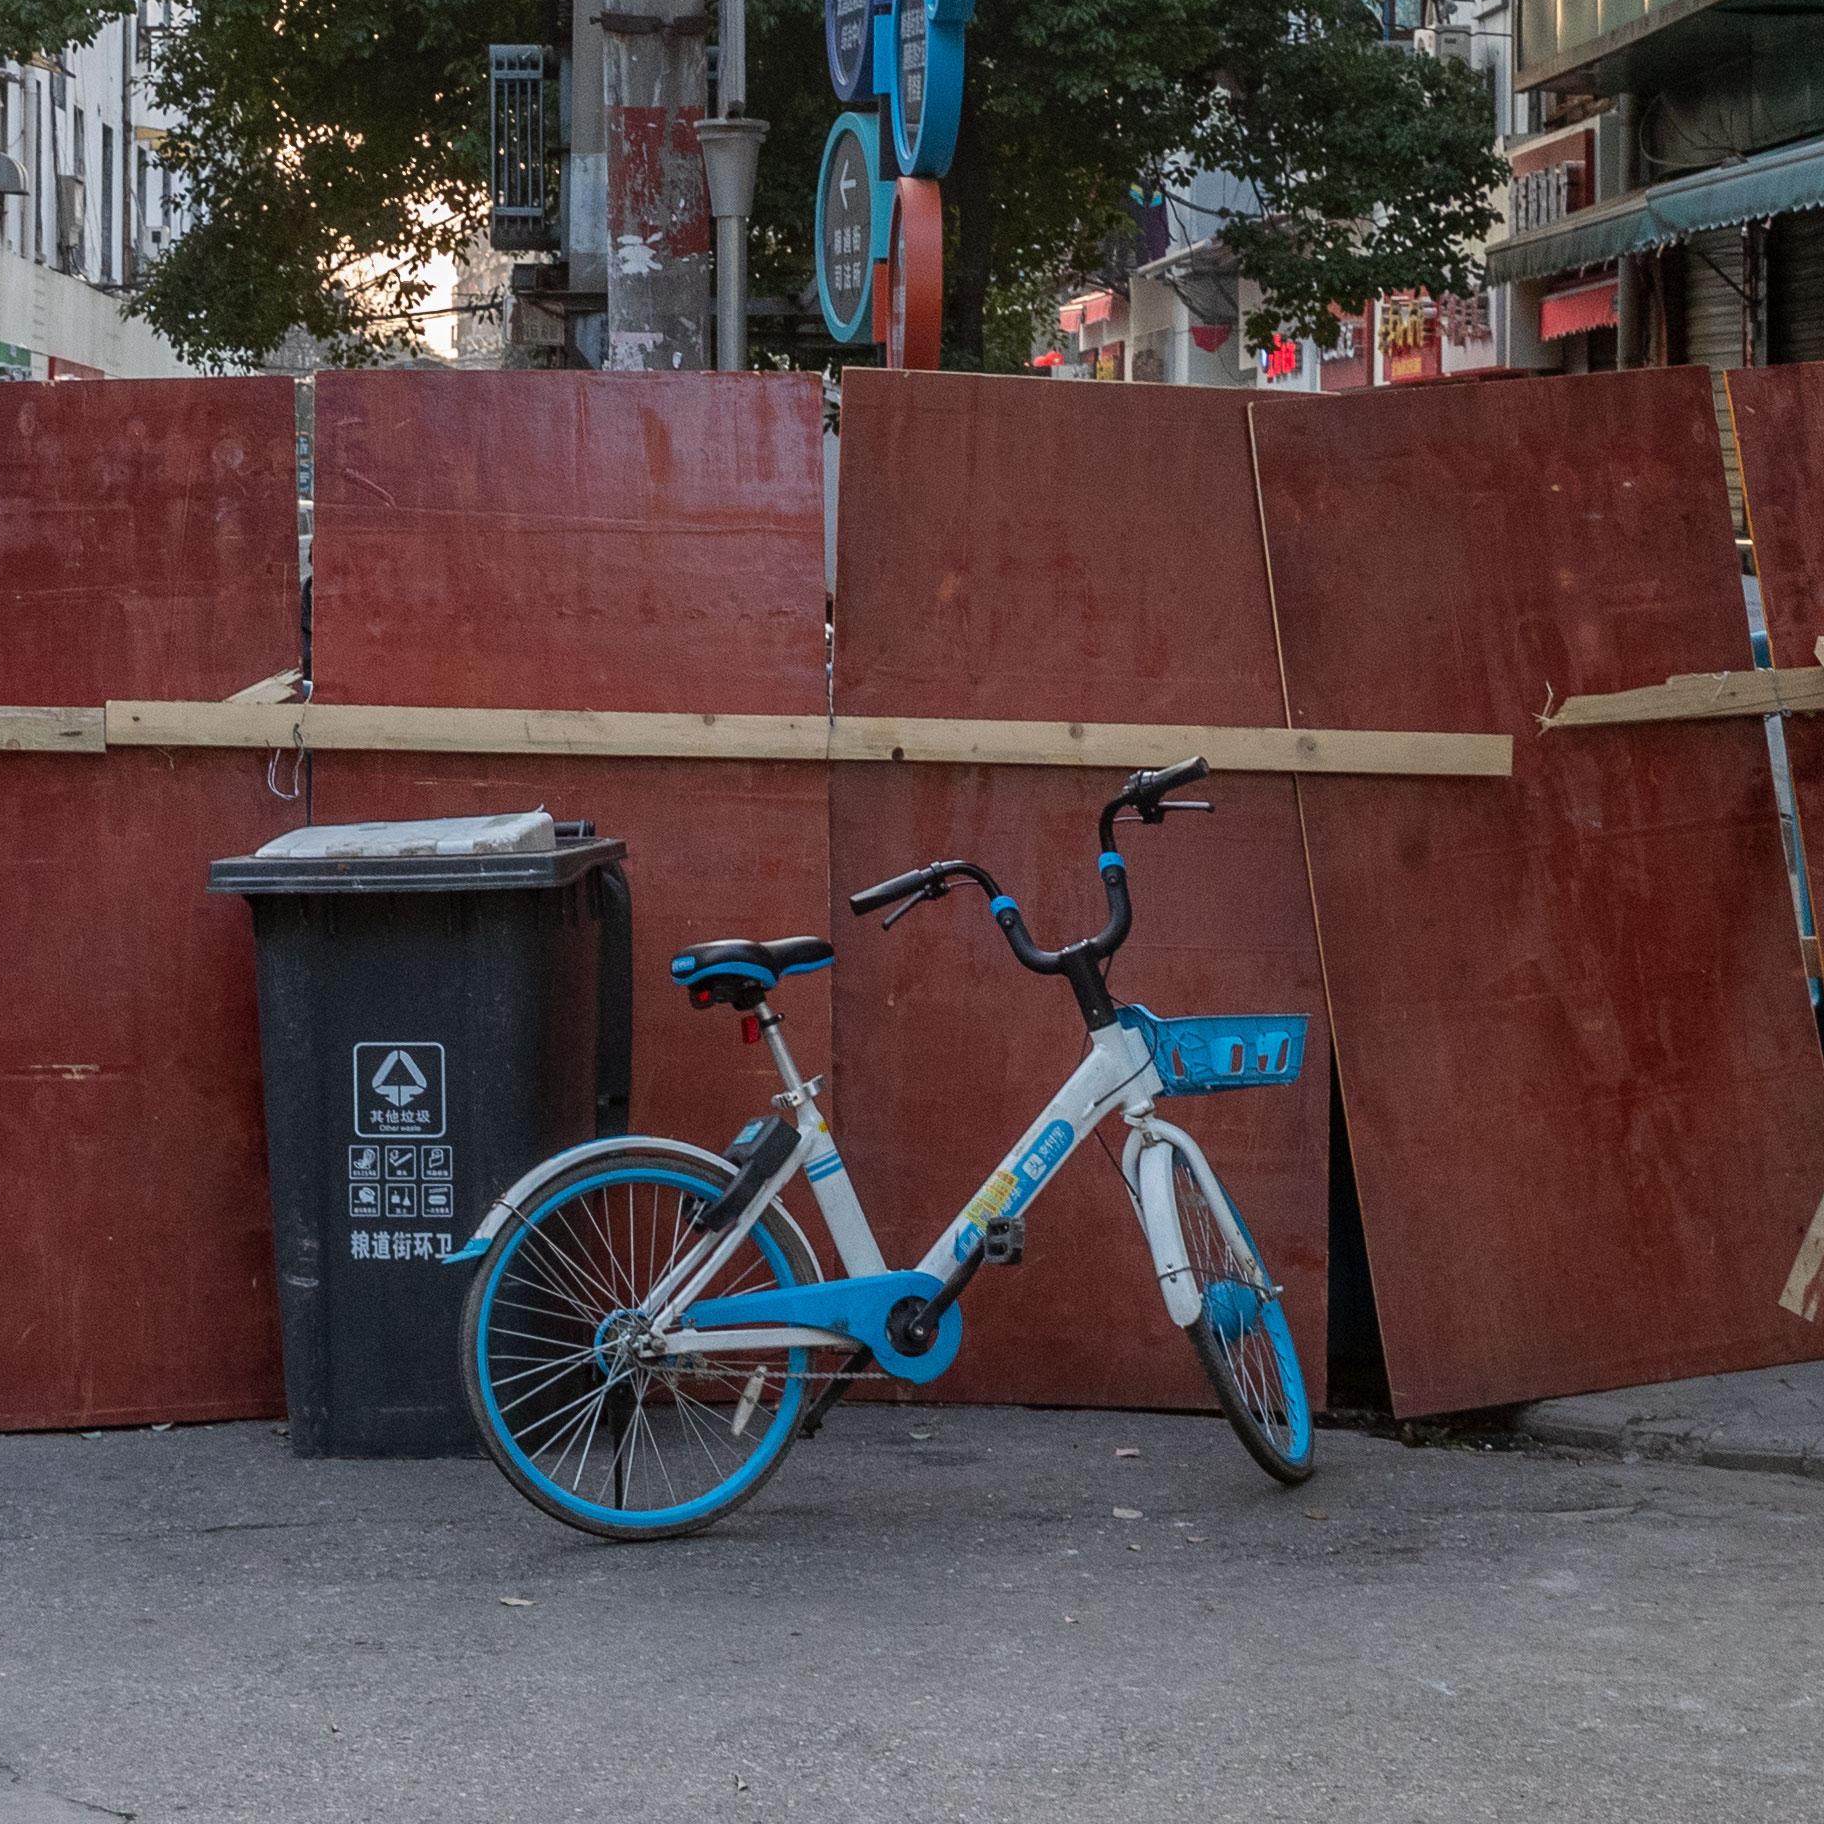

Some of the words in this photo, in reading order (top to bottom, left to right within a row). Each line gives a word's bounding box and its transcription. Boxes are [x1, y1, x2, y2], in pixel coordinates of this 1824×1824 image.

[370, 1110, 431, 1125] 其他垃圾
[350, 1230, 453, 1260] 粮道街环卫
